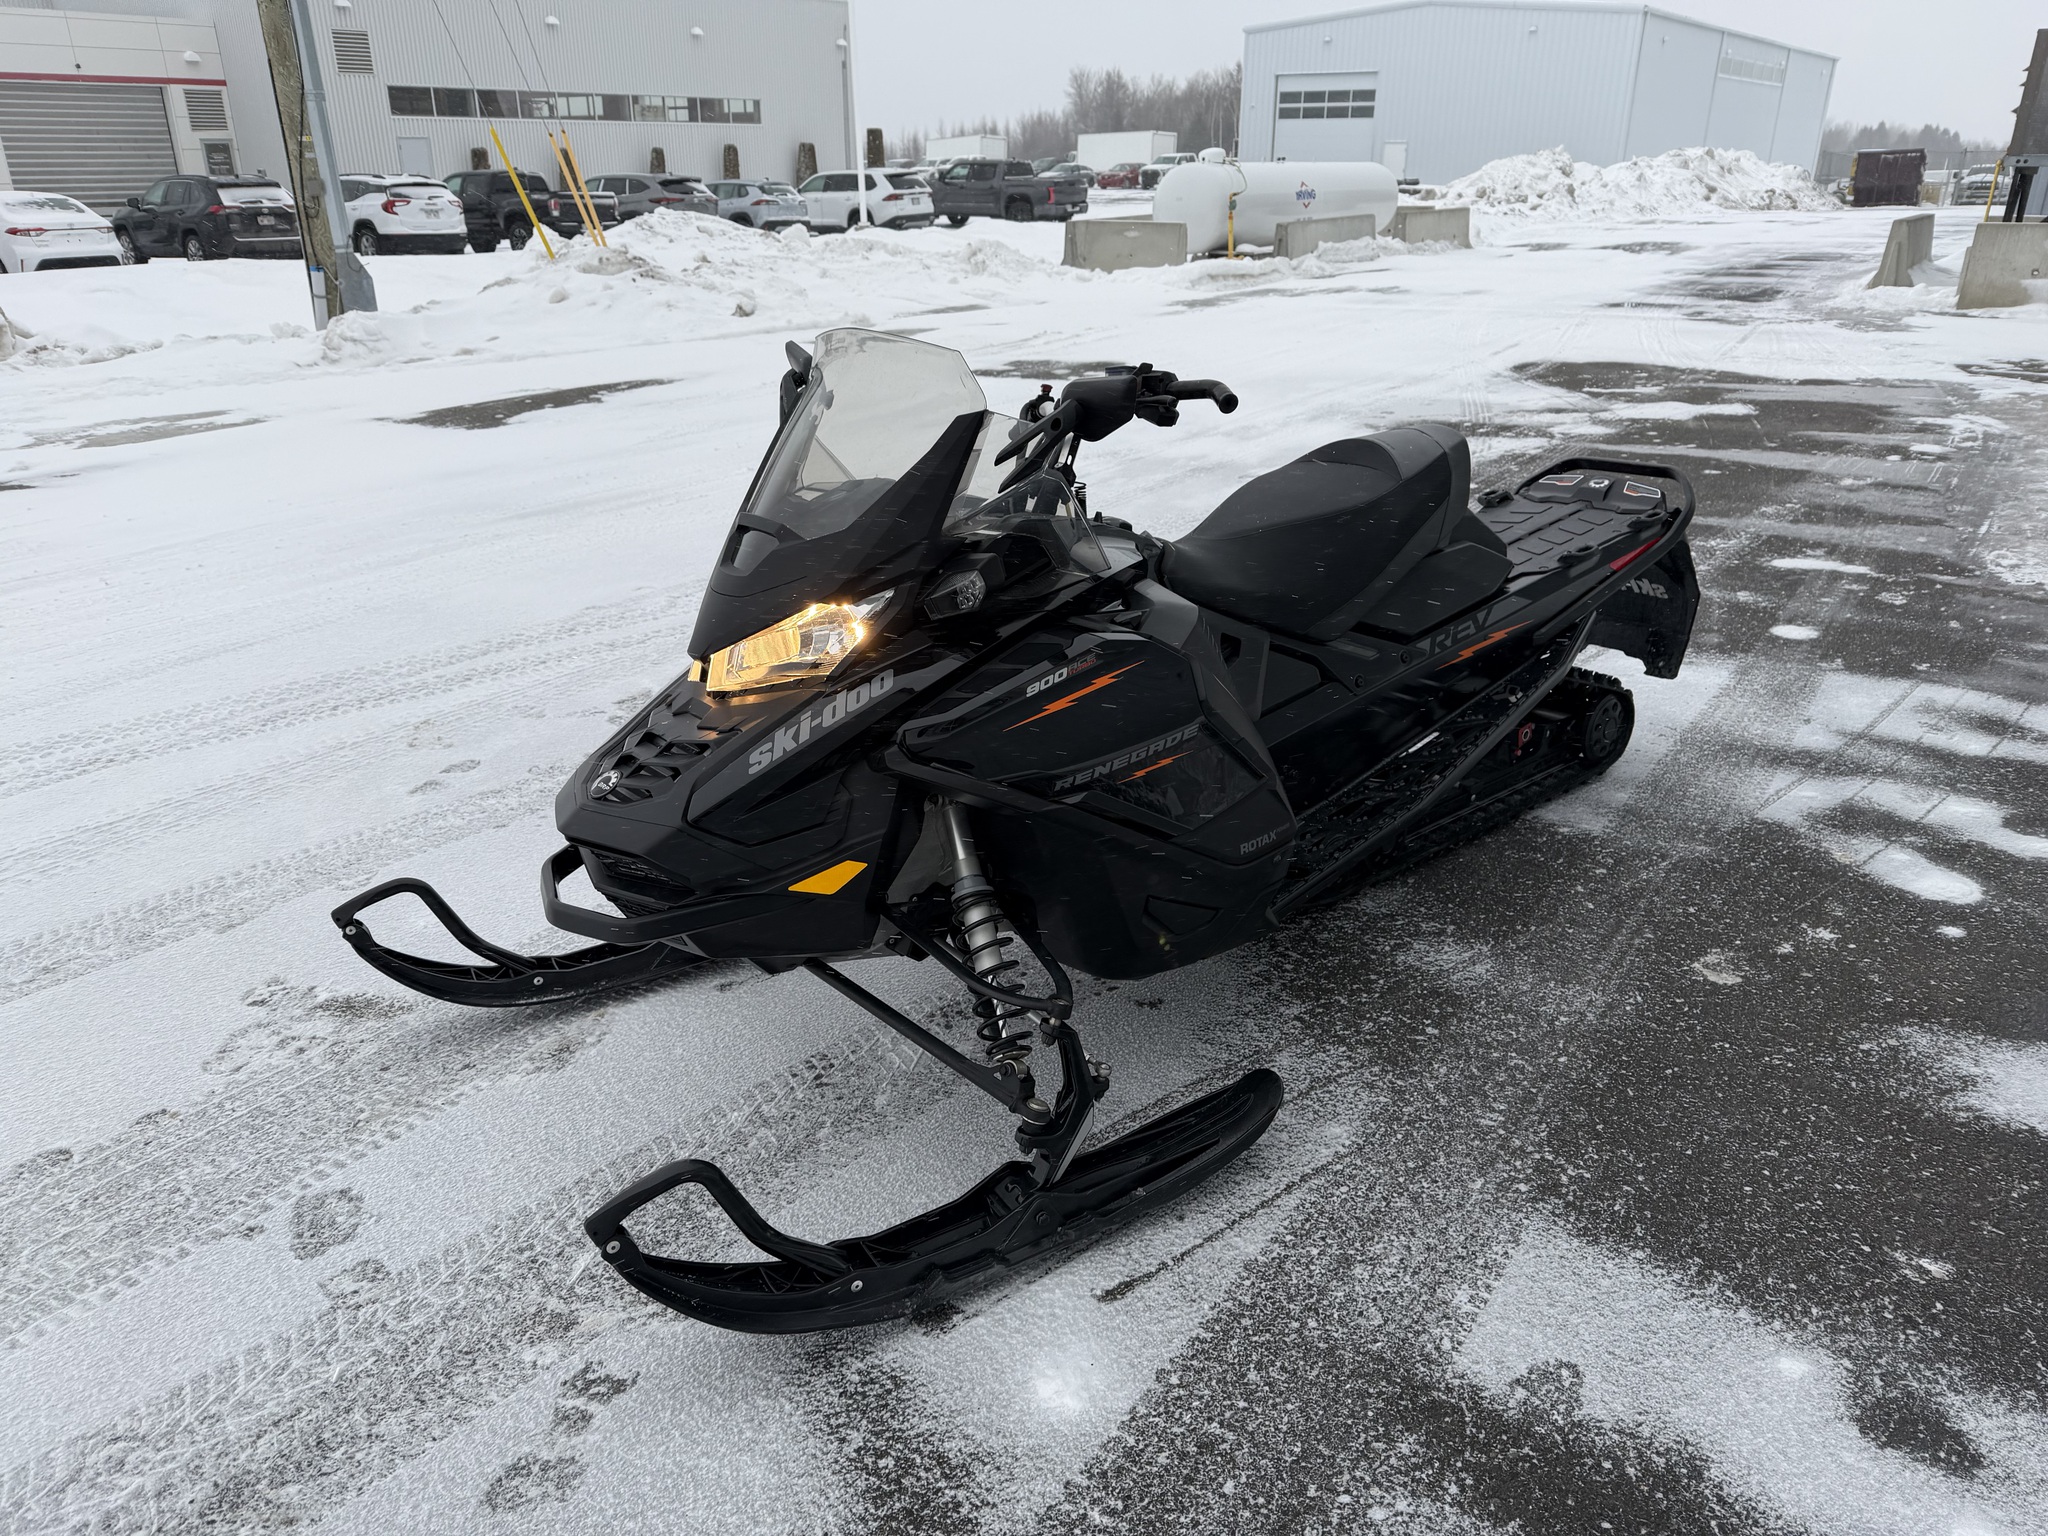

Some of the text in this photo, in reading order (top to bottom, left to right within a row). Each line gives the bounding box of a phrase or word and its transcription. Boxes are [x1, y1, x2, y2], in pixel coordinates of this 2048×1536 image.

[1427, 605, 1494, 657] REV
[1025, 652, 1096, 698] 900 ACE
[748, 668, 894, 774] ski-doo
[1053, 723, 1200, 792] RENEGADE
[1239, 828, 1277, 856] ROTAX
